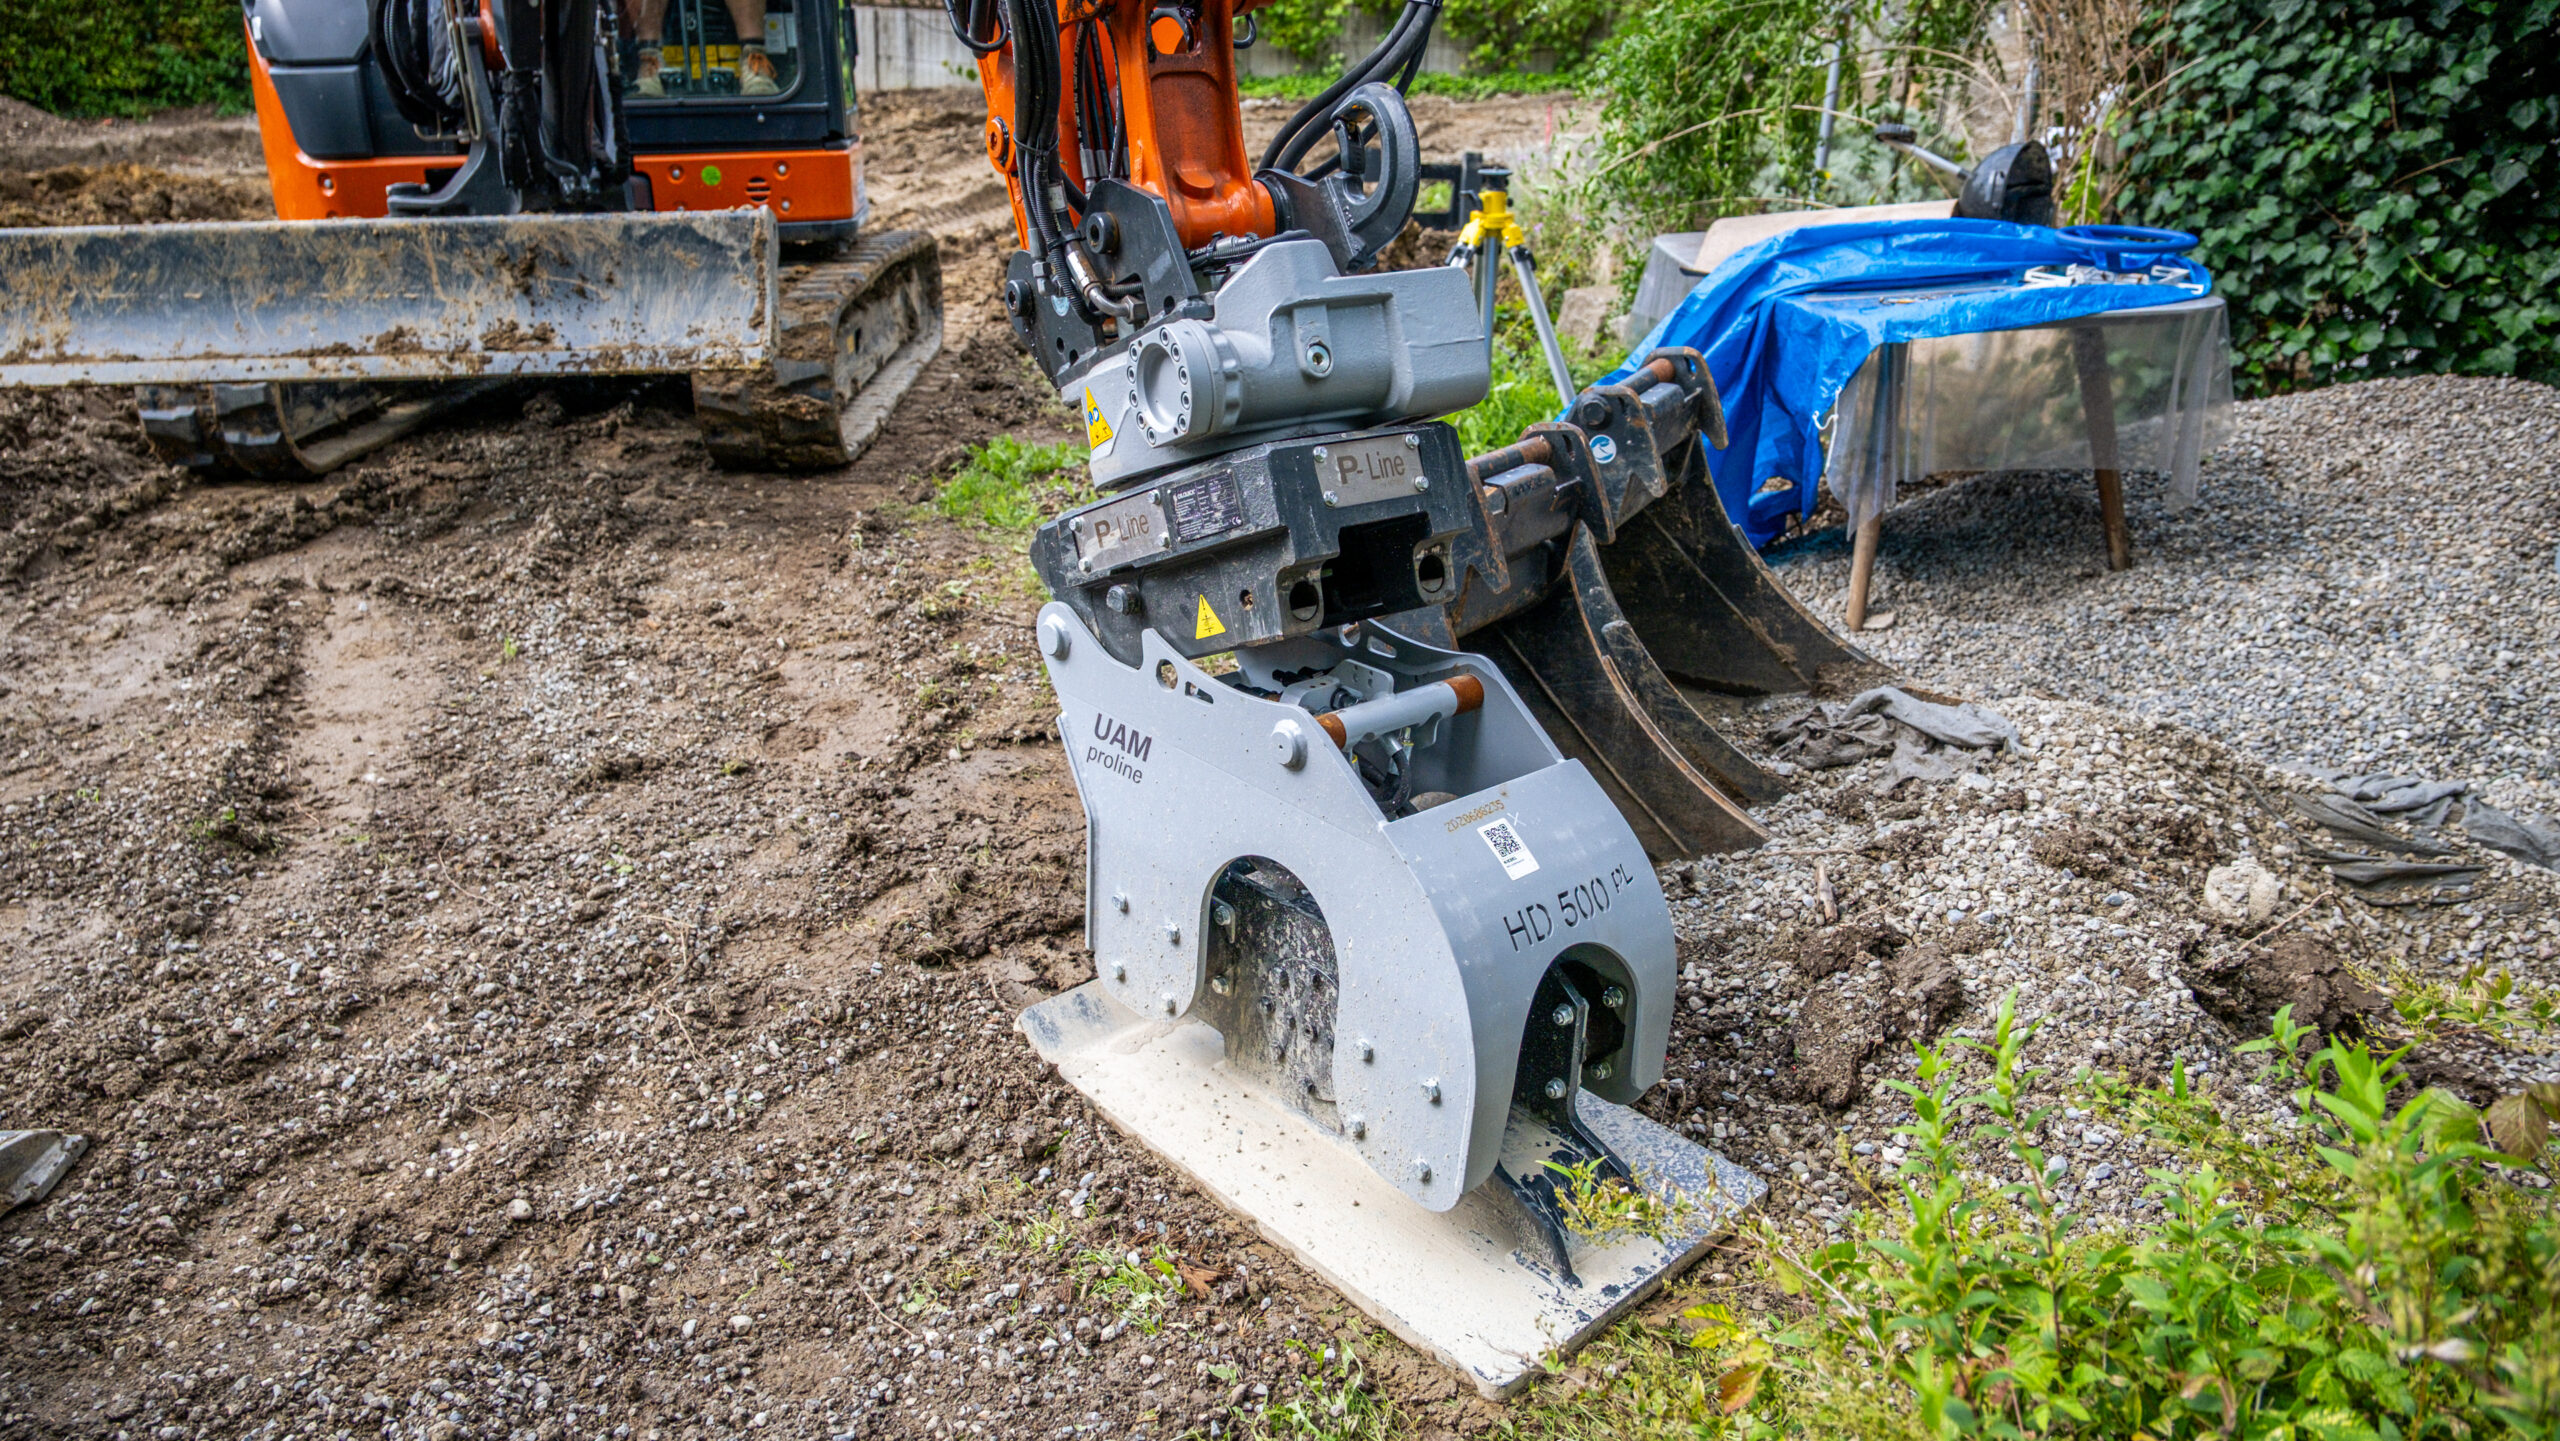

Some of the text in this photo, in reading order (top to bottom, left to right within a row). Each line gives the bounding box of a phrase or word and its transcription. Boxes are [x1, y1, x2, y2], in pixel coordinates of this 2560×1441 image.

[1094, 712, 1152, 763] UAM
[1086, 745, 1143, 784] proline
[1503, 863, 1634, 952] HD 500 PL
